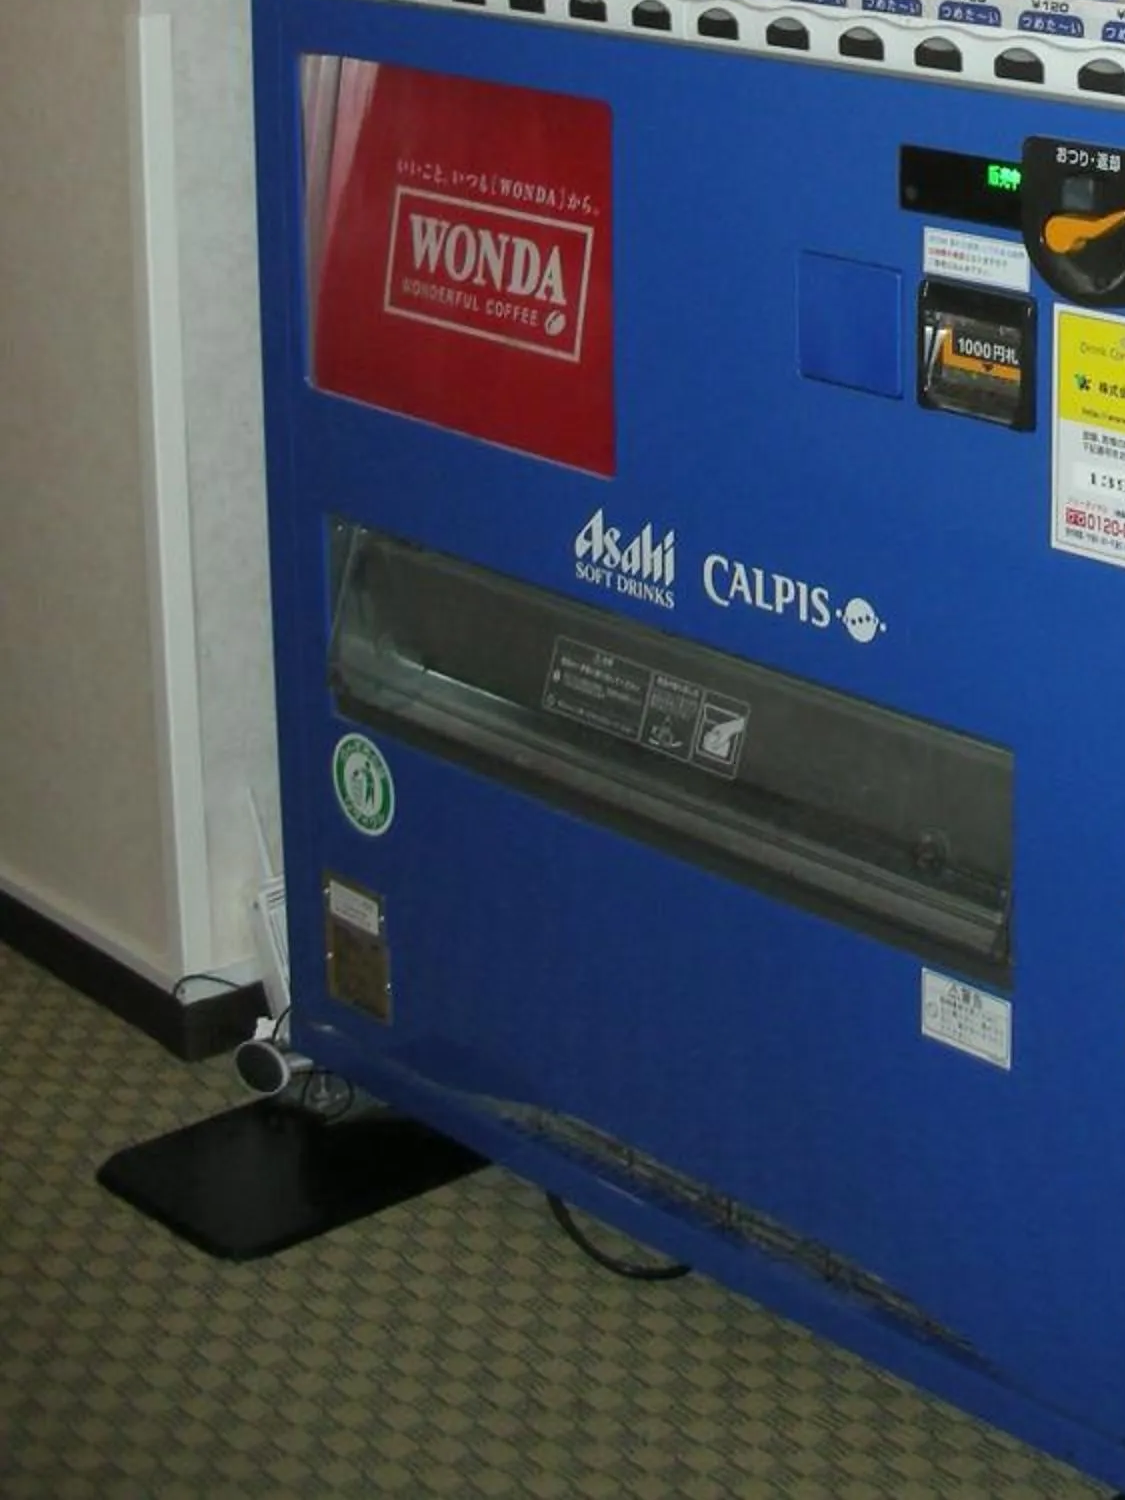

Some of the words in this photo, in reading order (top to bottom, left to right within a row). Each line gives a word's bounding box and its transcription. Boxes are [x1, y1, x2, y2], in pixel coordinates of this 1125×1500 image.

[1032, 0, 1069, 14] ¥120
[409, 213, 568, 307] WONDA
[402, 277, 481, 312] WONDERFUL
[485, 299, 540, 328] COFFEE
[957, 336, 1020, 366] 1000円札
[575, 507, 676, 586] Asahi
[575, 561, 611, 588] SOFT
[616, 574, 675, 610] DRINKS
[703, 554, 831, 628] CALPIS
